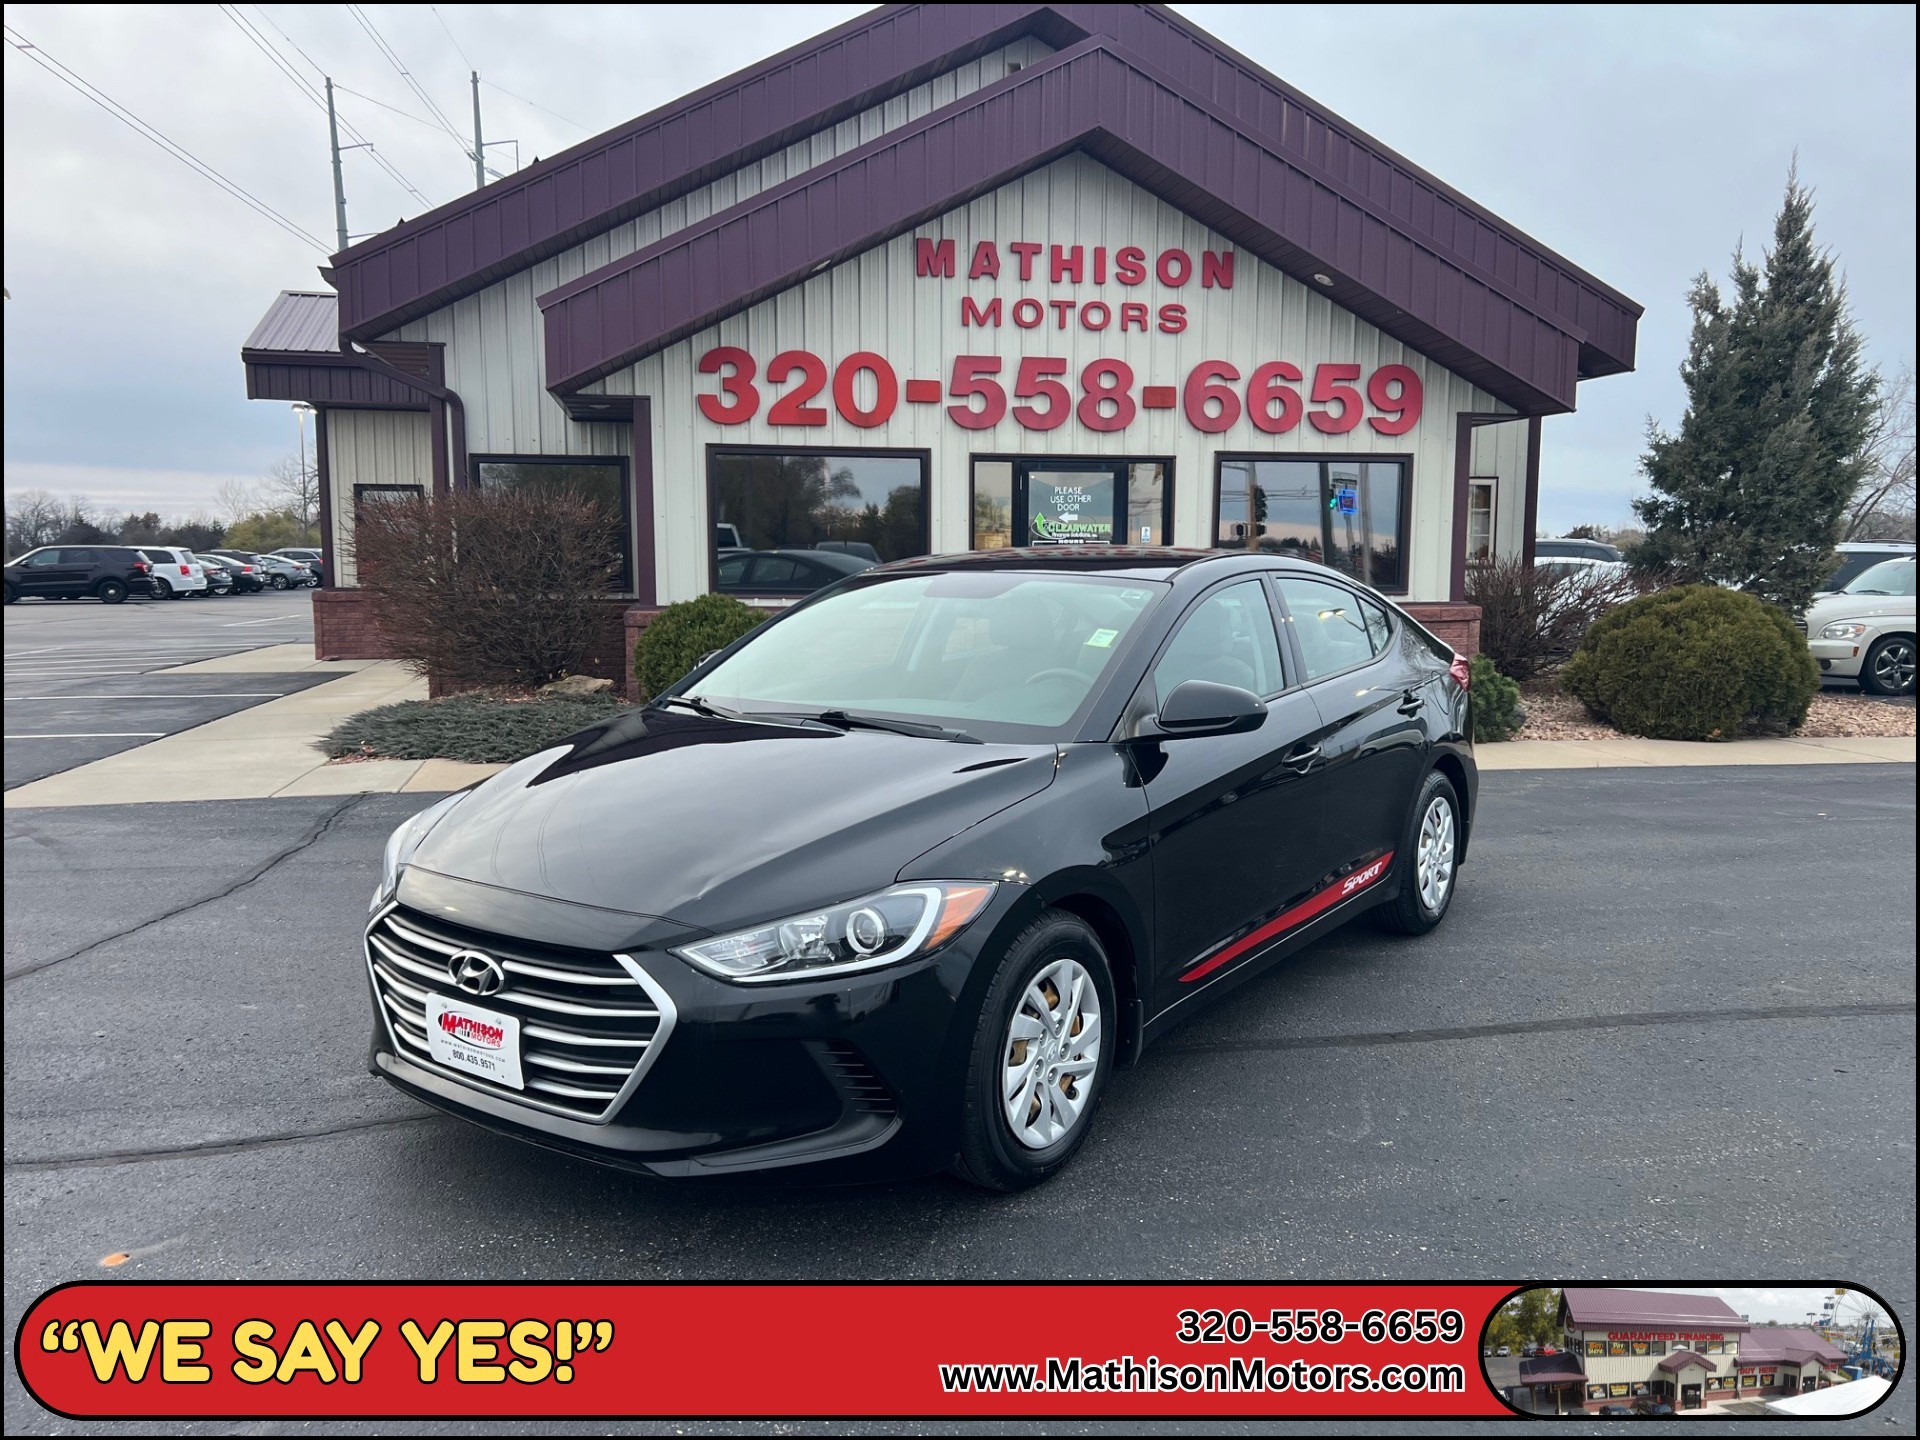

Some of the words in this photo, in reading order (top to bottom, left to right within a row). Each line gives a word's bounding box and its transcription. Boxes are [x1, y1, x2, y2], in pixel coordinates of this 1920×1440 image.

[916, 238, 1234, 289] MATHISON
[962, 296, 1188, 334] MOTORS
[697, 346, 1424, 436] 320-558-6659
[1050, 495, 1065, 504] USE
[1067, 494, 1092, 503] OTHER
[1054, 486, 1082, 495] PLEASE
[1057, 503, 1080, 512] DOOR
[1048, 523, 1111, 532] CLEARWATER
[1341, 861, 1383, 895] SPORT
[442, 1013, 503, 1041] MATHISON
[471, 1033, 501, 1047] MOTORS
[452, 1049, 496, 1071] 800.435.9571
